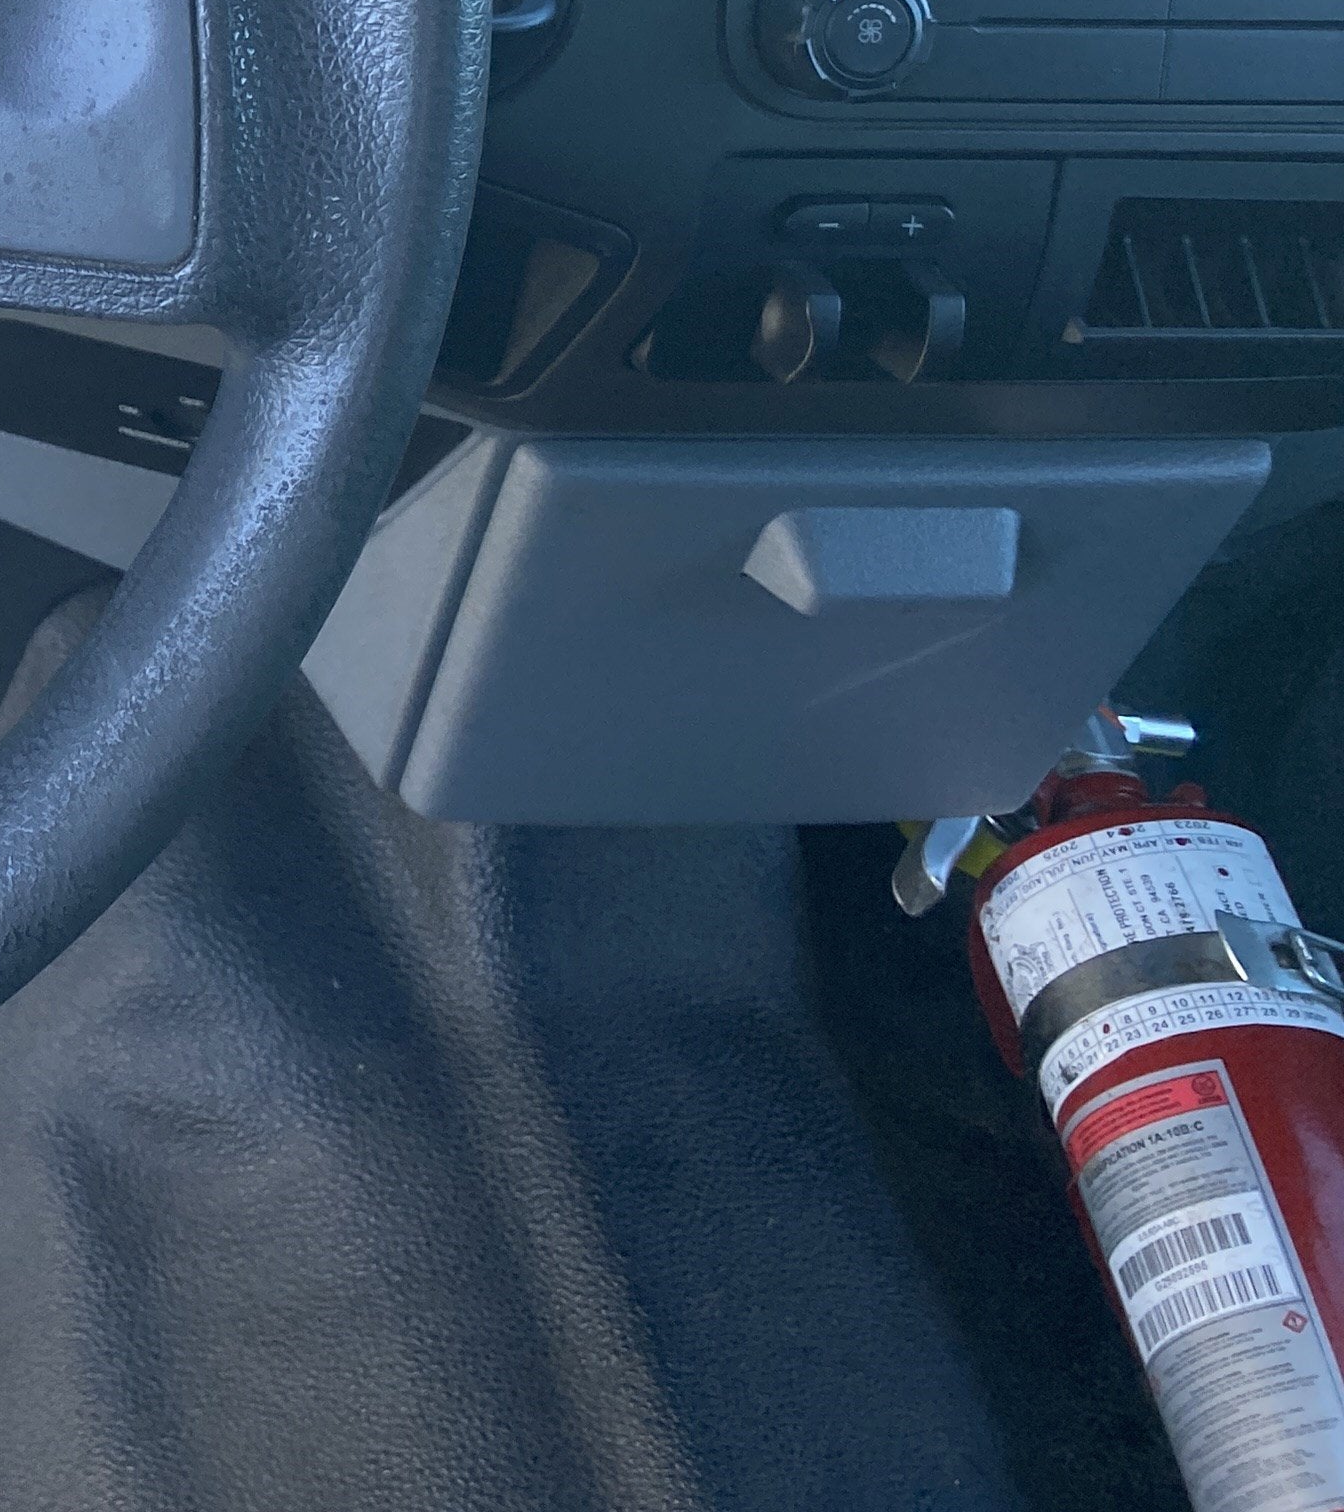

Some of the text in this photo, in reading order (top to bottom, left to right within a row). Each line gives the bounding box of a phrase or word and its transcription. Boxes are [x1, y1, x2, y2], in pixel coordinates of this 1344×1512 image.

[1106, 823, 1147, 839] 204
[1102, 845, 1128, 859] MAY
[1132, 839, 1158, 852] APR
[1072, 853, 1097, 866] JUN
[1047, 860, 1067, 878] JUL
[1096, 868, 1133, 930] PROTECTION
[1147, 1005, 1158, 1017] 9
[1171, 997, 1189, 1010] 10
[1199, 993, 1216, 1005] 11
[1226, 990, 1245, 1002] 12
[1254, 990, 1271, 1002] 13
[1103, 1038, 1121, 1053] 22
[1125, 1028, 1142, 1042] 23
[1152, 1019, 1170, 1033] 24
[1177, 1012, 1197, 1026] 25
[1205, 1009, 1225, 1021] 26
[1234, 1006, 1252, 1018] 27
[1261, 1006, 1279, 1018] 28
